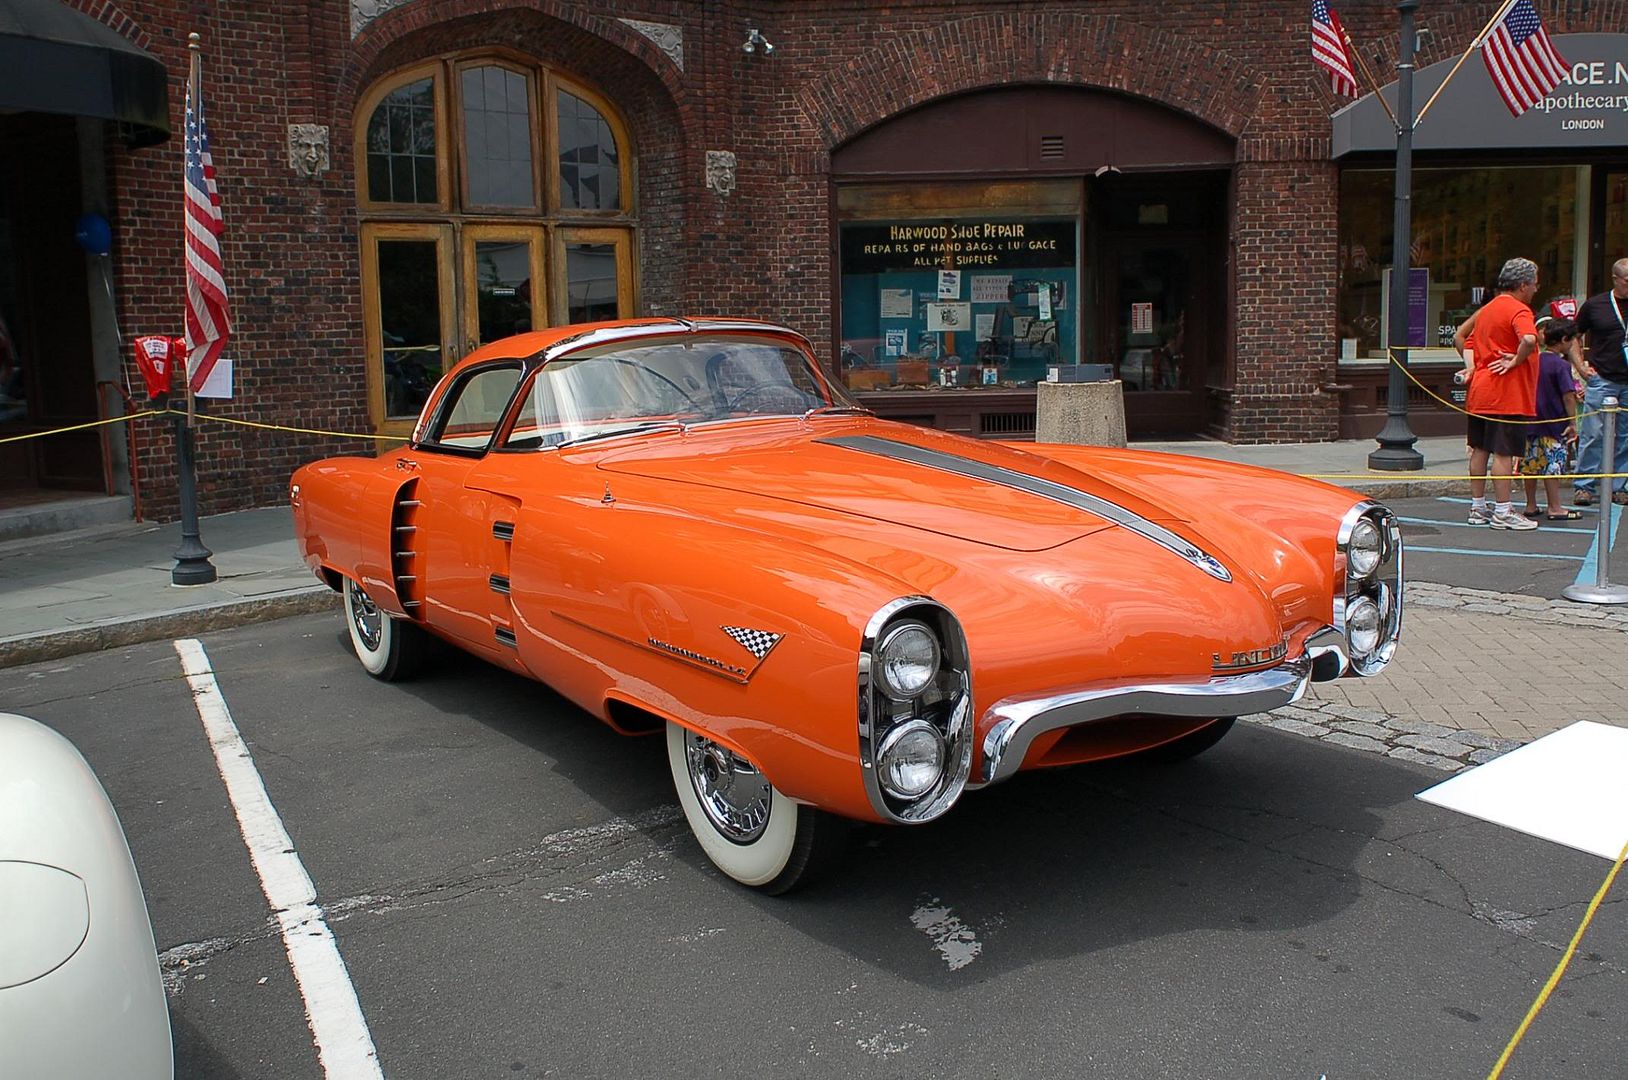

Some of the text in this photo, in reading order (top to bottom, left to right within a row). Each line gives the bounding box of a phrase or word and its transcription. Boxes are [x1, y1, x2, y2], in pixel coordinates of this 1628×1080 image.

[1534, 92, 1628, 114] apothecary
[1561, 119, 1605, 130] LONDON
[890, 225, 948, 240] HARWOOD
[984, 223, 1025, 238] REPAIR
[864, 244, 909, 254] REPARS
[913, 243, 926, 252] OF
[930, 242, 962, 252] HAND
[966, 242, 994, 252] BAGS
[914, 257, 932, 266] ALL
